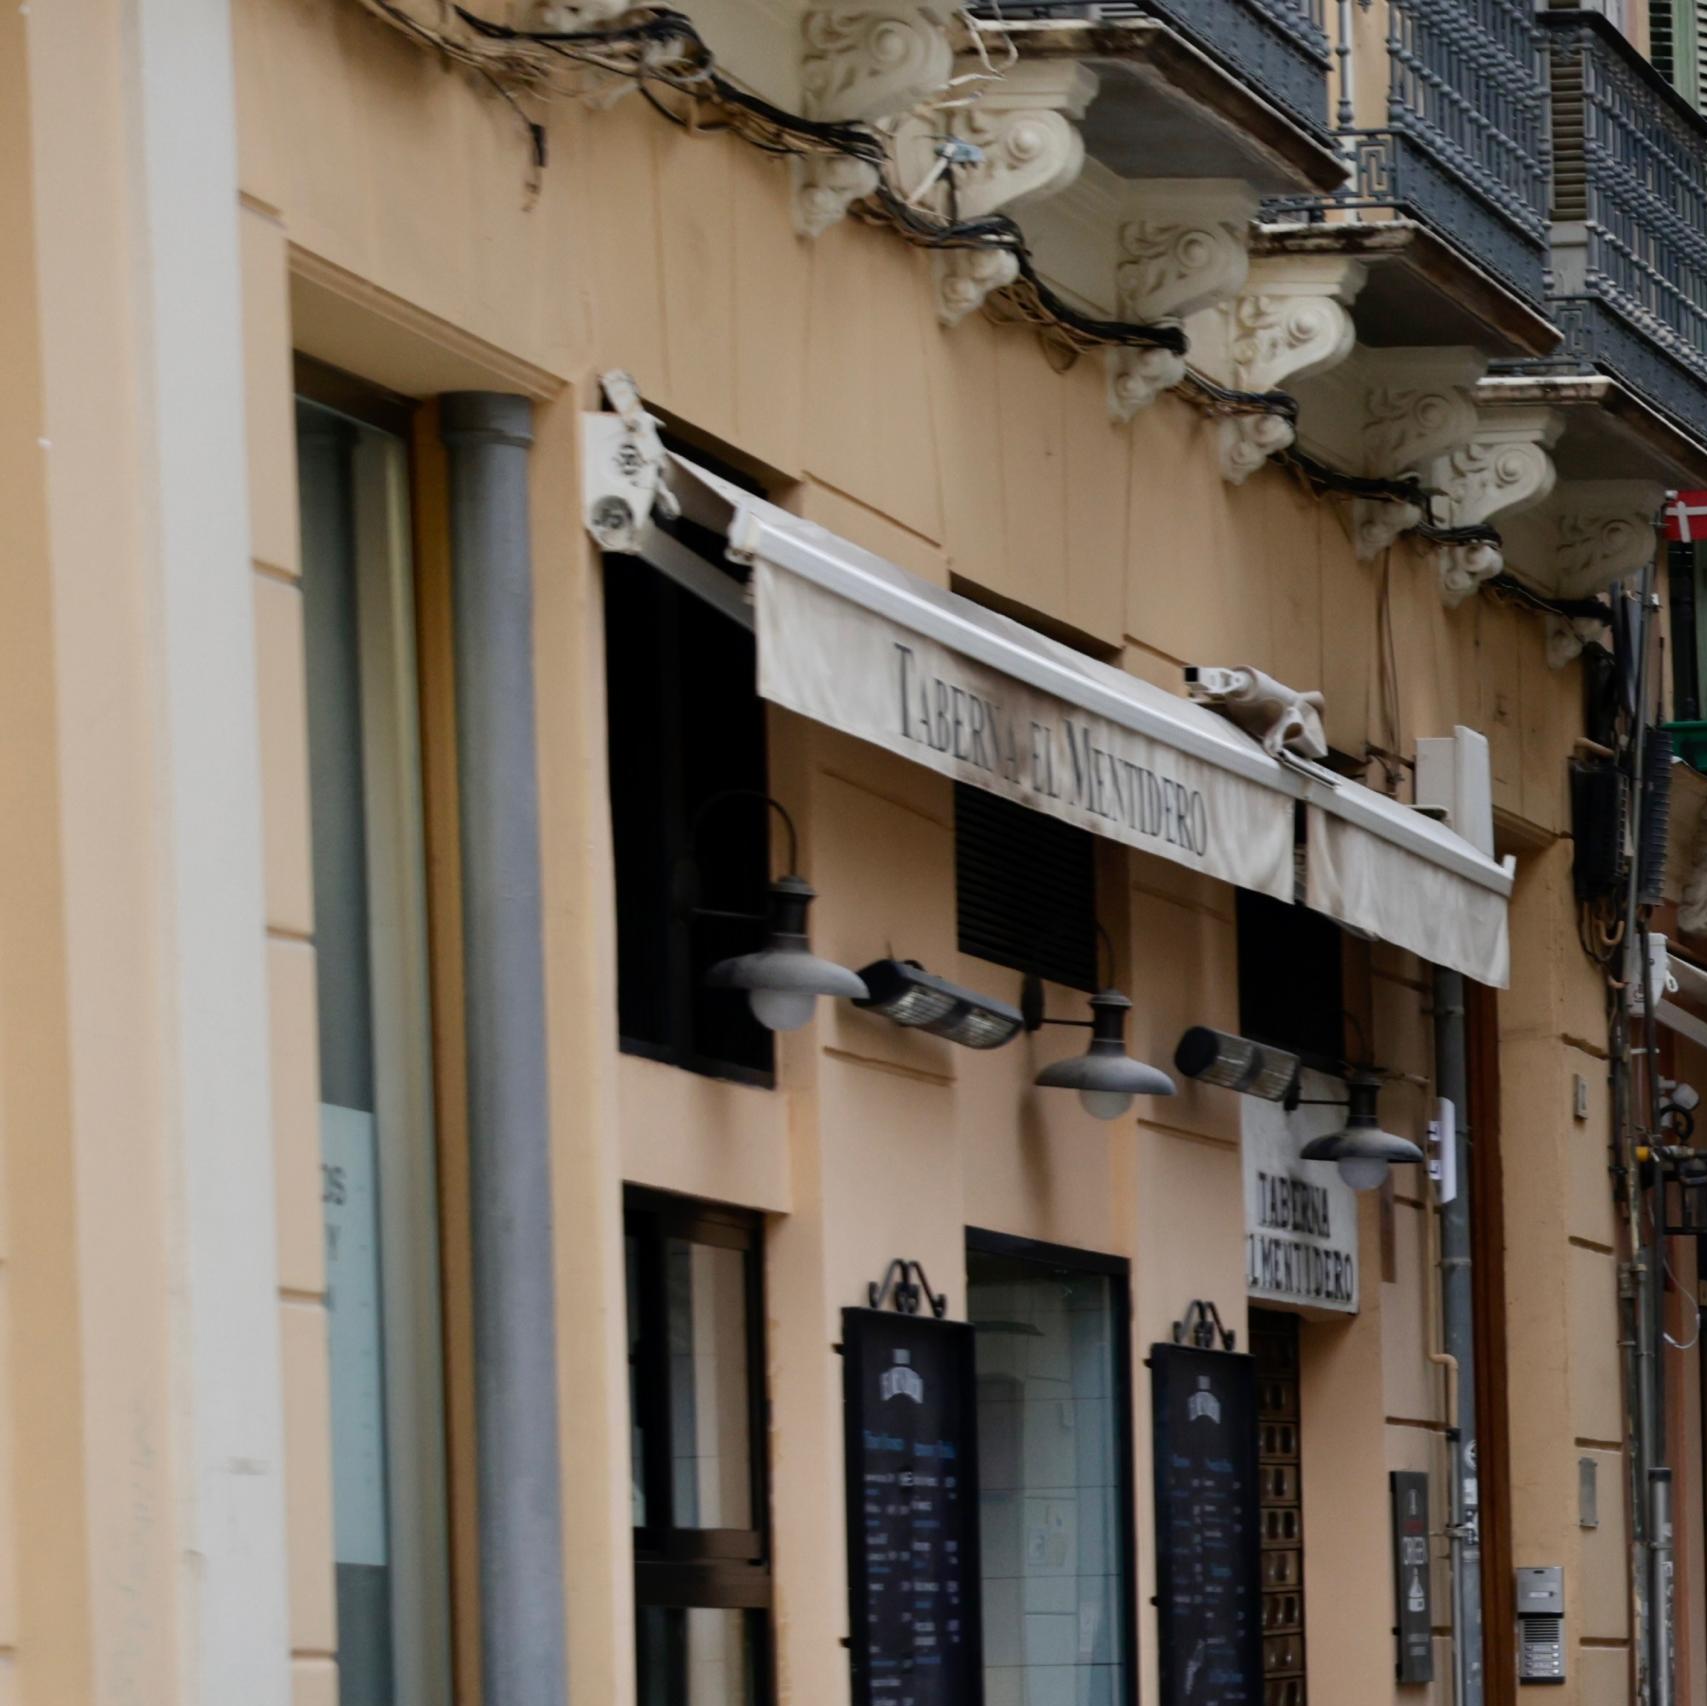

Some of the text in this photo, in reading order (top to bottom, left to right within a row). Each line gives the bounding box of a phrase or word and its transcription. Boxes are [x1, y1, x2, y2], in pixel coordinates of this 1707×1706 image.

[894, 642, 1208, 857] TABERNA EL MENTIDERO
[1257, 1170, 1331, 1239] TABERNA
[1260, 1235, 1354, 1303] MENTIDERO
